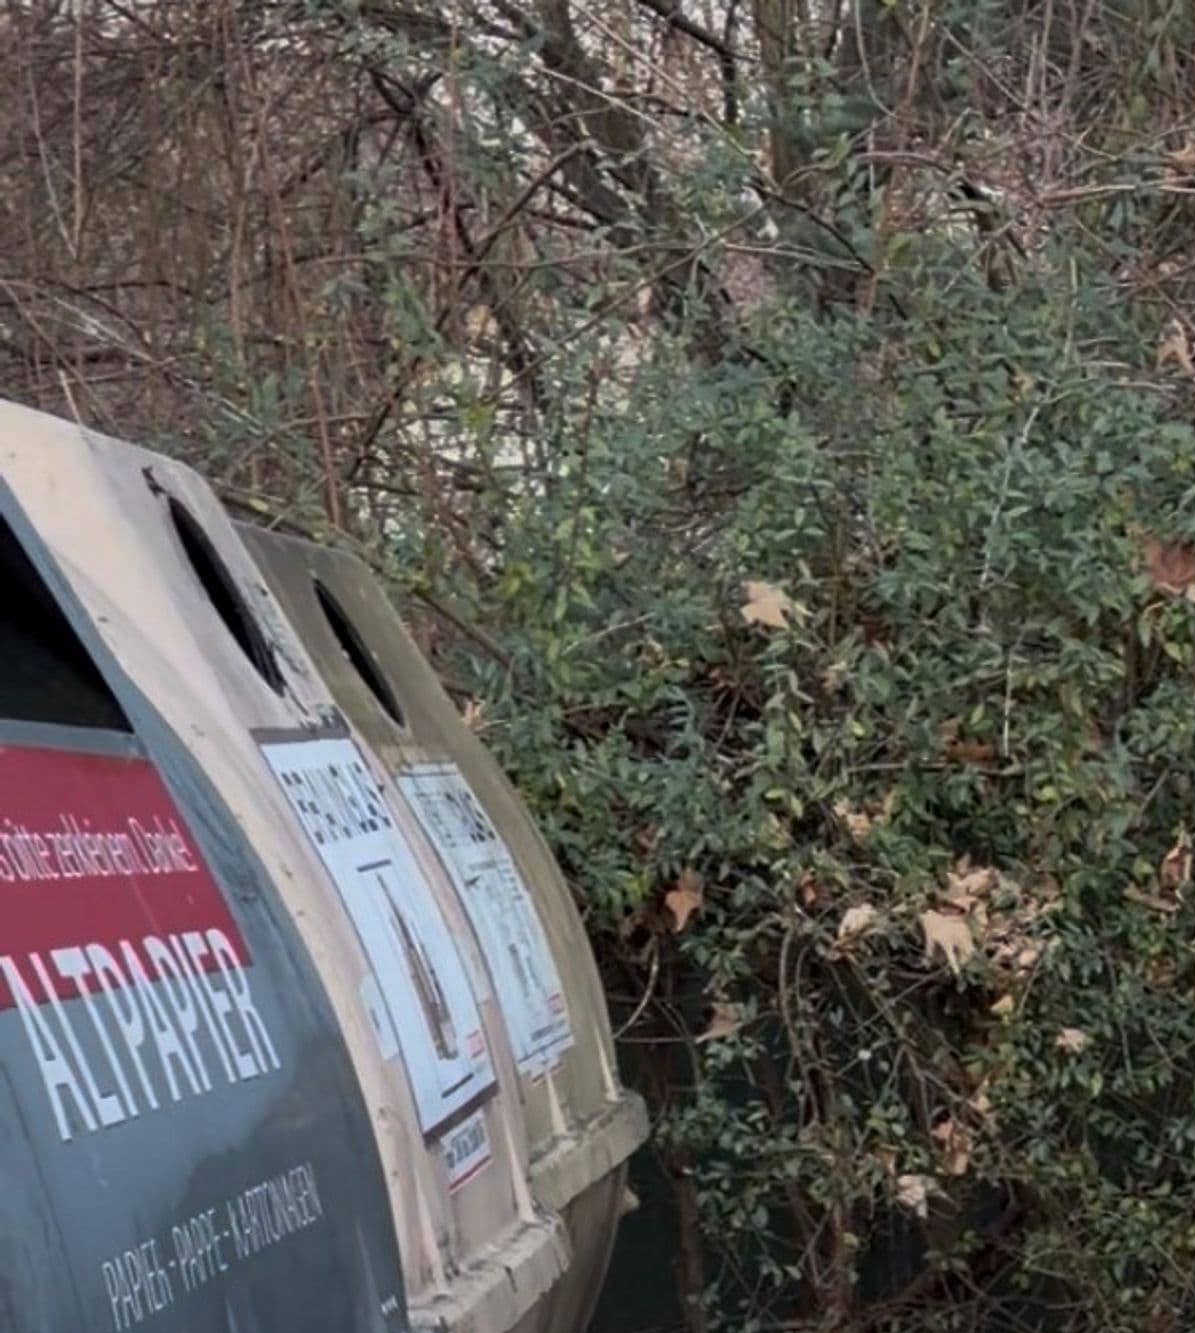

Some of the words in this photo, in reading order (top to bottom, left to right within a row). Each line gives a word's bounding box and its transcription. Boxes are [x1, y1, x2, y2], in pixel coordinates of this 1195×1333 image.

[0, 928, 282, 1141] ALTPAPIER
[103, 1238, 175, 1333] PAPIER
[172, 1208, 229, 1292] PAPPE
